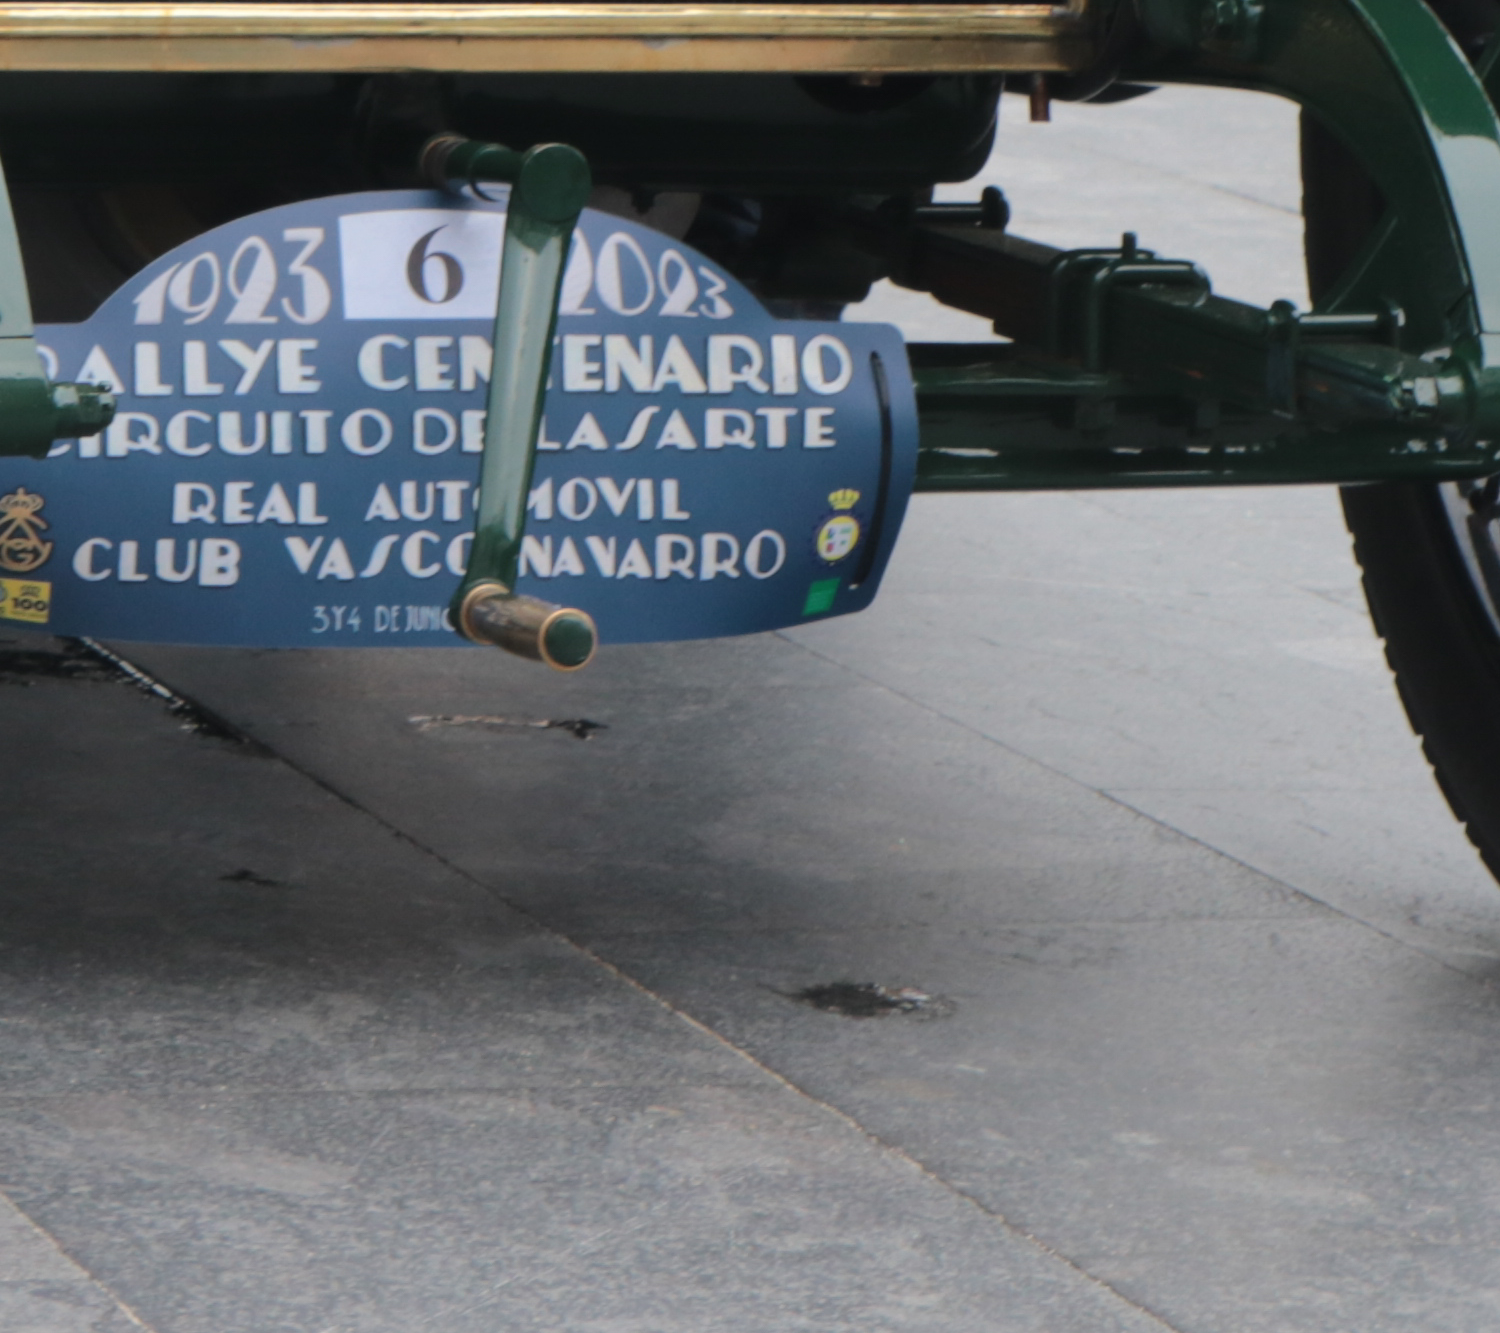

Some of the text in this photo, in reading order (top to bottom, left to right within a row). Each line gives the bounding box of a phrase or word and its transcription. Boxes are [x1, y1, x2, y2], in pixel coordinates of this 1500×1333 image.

[132, 227, 332, 325] 1923
[406, 225, 465, 305] 6
[357, 333, 853, 396] CENENARIO
[172, 476, 692, 526] REAL AUTMOVIL
[72, 537, 242, 588] CLUB
